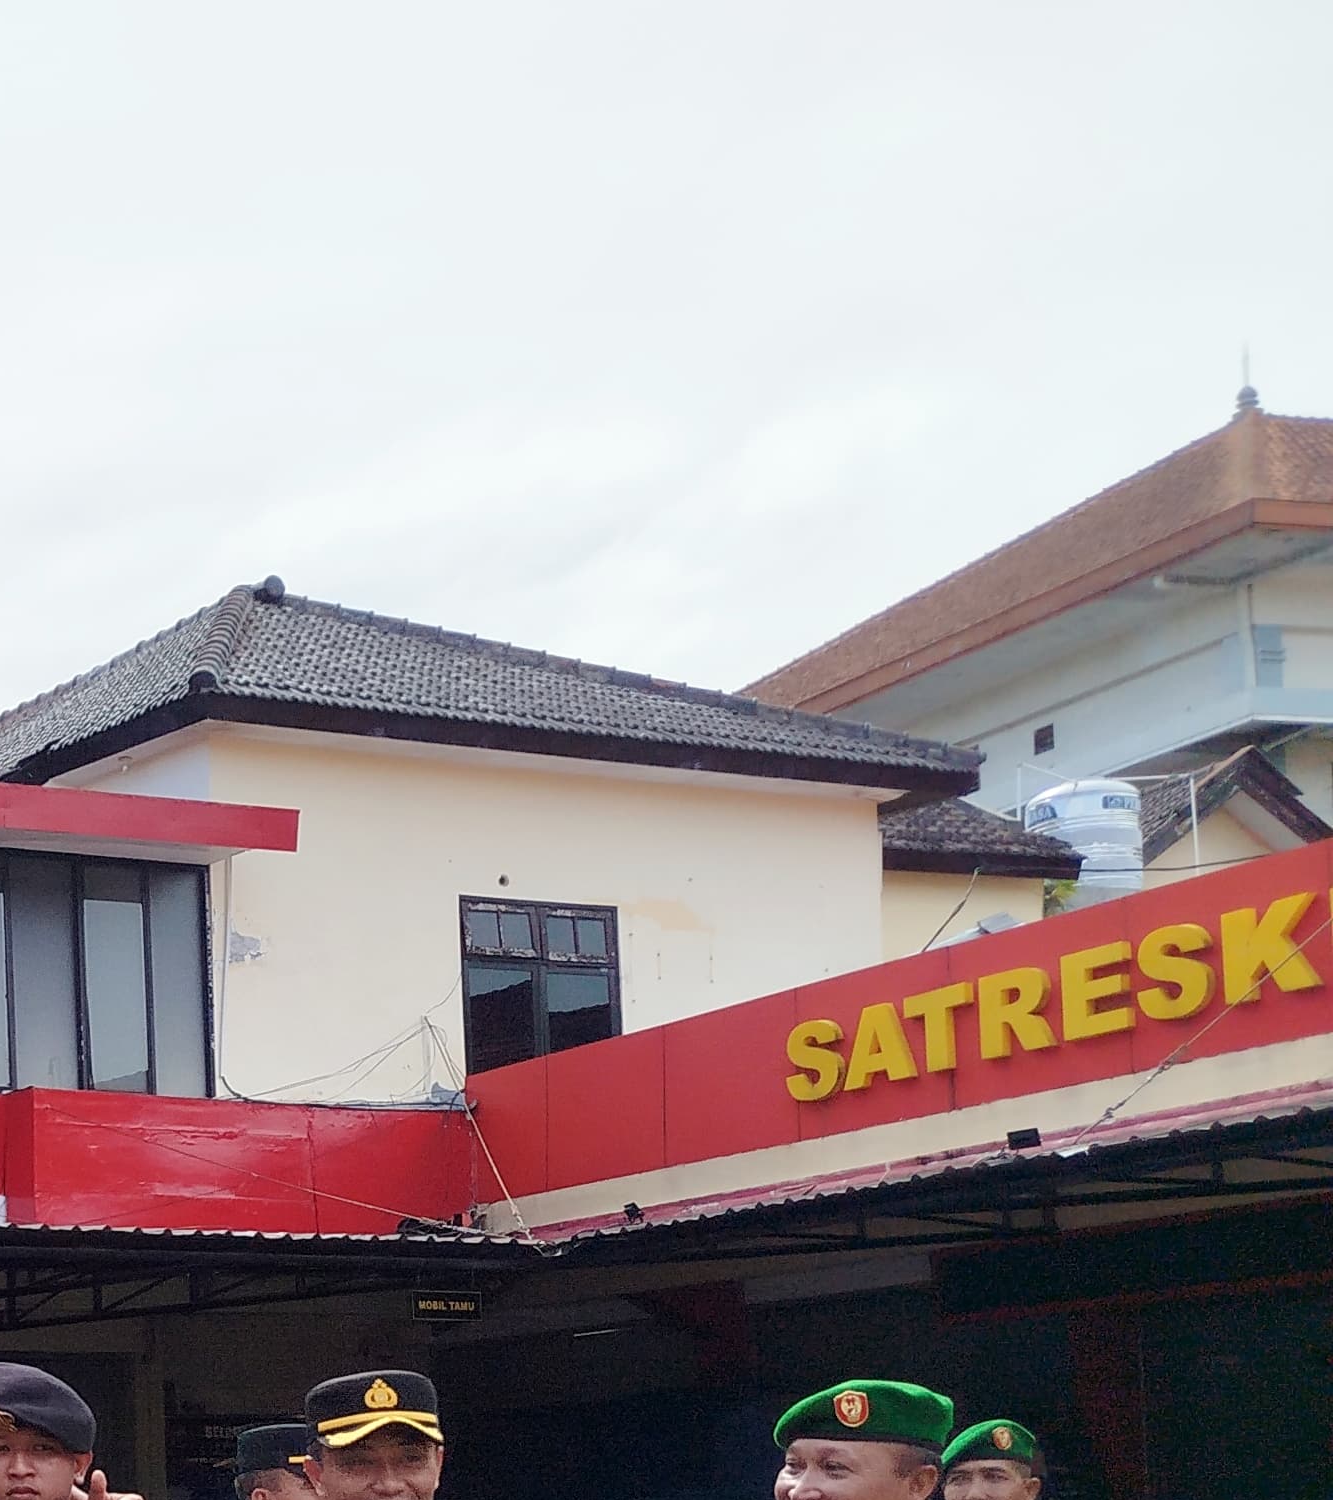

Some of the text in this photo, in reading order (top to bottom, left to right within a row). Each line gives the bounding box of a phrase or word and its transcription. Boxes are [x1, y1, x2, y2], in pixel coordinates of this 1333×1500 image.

[786, 891, 1333, 1102] SATRESK
[418, 1300, 475, 1311] MOBIL TAMU
